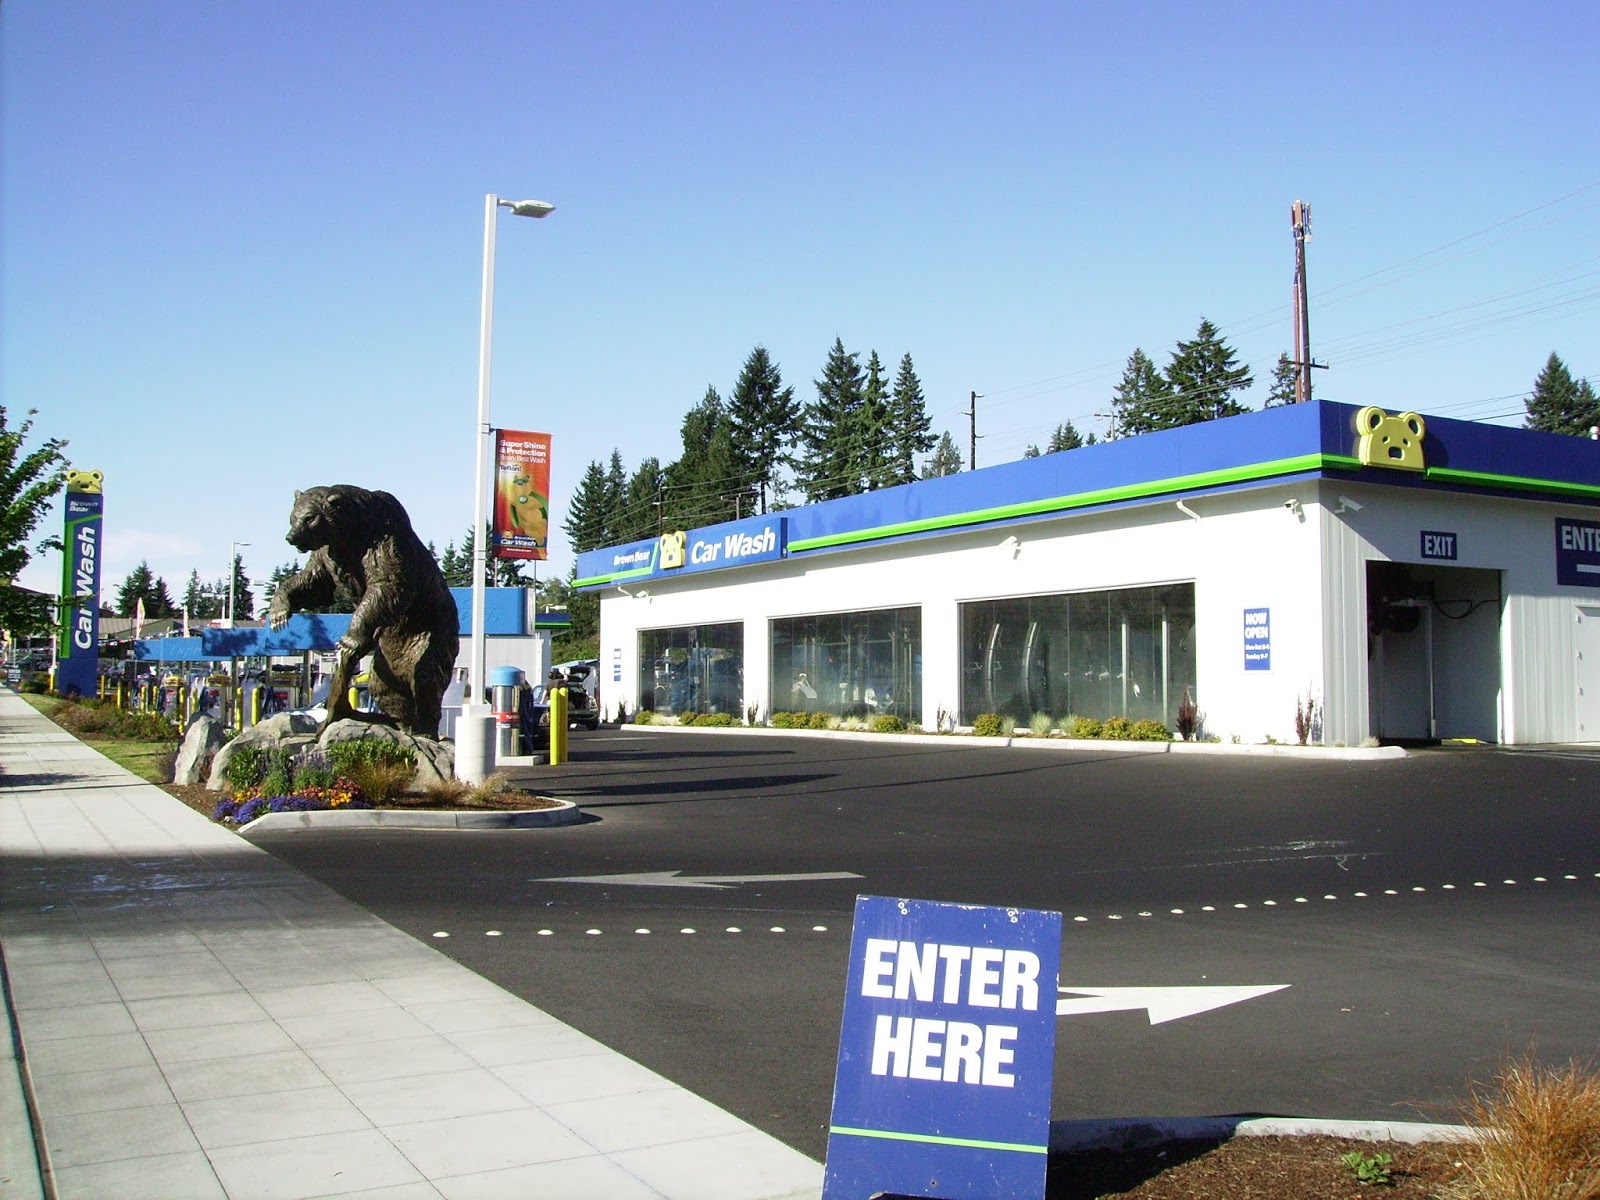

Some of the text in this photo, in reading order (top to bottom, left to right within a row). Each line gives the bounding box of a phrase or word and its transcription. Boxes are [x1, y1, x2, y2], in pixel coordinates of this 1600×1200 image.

[500, 440, 546, 450] Super Shine
[507, 448, 546, 457] Protection
[691, 527, 776, 565] Car Wash
[1424, 535, 1453, 557] EXIT
[76, 526, 96, 597] Wash
[613, 551, 650, 566] Brown Bear
[1245, 612, 1267, 625] NOW
[1245, 626, 1268, 639] OPEN
[861, 938, 1041, 1011] ENTER
[871, 1014, 1018, 1088] HERE
